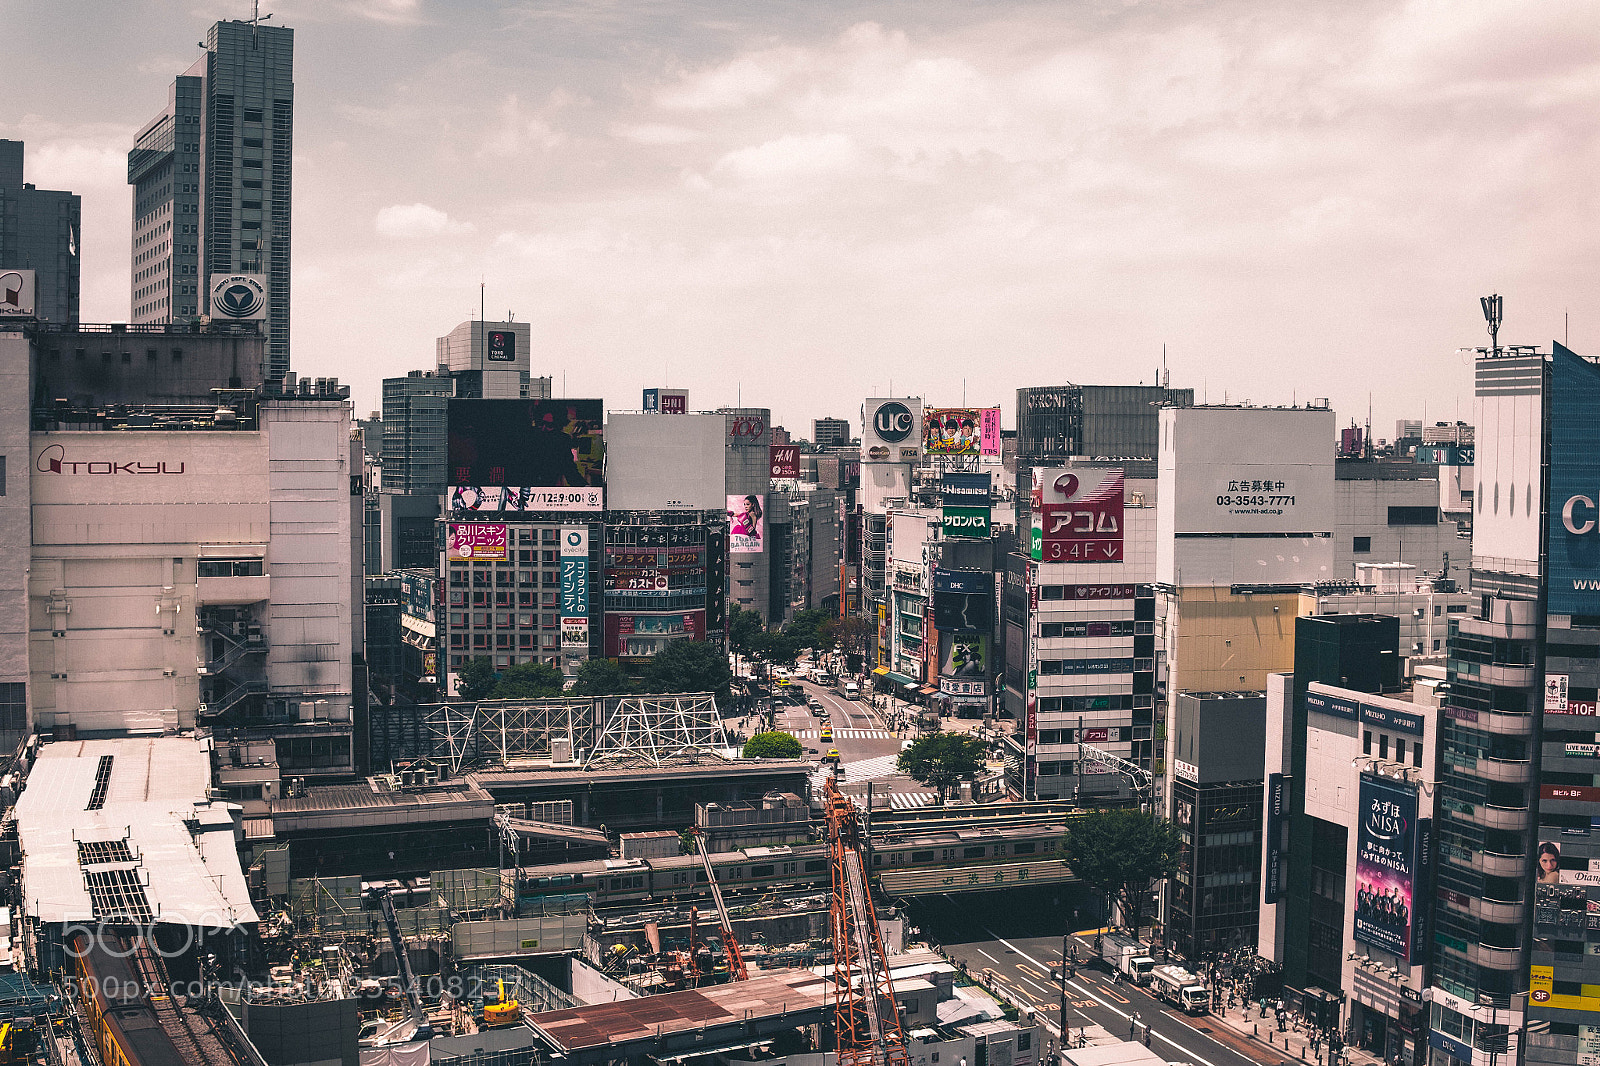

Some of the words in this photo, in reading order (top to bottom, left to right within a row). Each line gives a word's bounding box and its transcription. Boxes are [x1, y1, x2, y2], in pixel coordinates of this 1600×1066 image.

[729, 420, 764, 442] 109
[63, 461, 185, 475] TOKYU
[946, 484, 988, 495] Hisamitsu
[1227, 480, 1285, 493] 広告募集中
[559, 493, 581, 503] 9:00
[1216, 496, 1296, 506] 03-3543-7771
[1234, 508, 1284, 516] www.hit-ad.co.jp
[1562, 494, 1600, 534] C
[943, 516, 986, 527] サロンパス
[1050, 511, 1118, 533] アコム
[457, 525, 505, 536] 品川スキン
[457, 535, 505, 546] クリニック
[563, 561, 576, 613] アイシティ
[577, 561, 586, 613] コンタクトの
[628, 578, 653, 588] ガスト
[1089, 587, 1122, 596] アイフル
[953, 643, 971, 653] FX
[1364, 709, 1386, 721] MIZUHO
[1573, 703, 1595, 716] 10F
[1273, 784, 1282, 816] MIZUHO
[1371, 798, 1401, 818] みずほ
[1371, 813, 1400, 835] NISA
[1422, 832, 1430, 865] MIZUHO
[1534, 991, 1547, 1000] 3F
